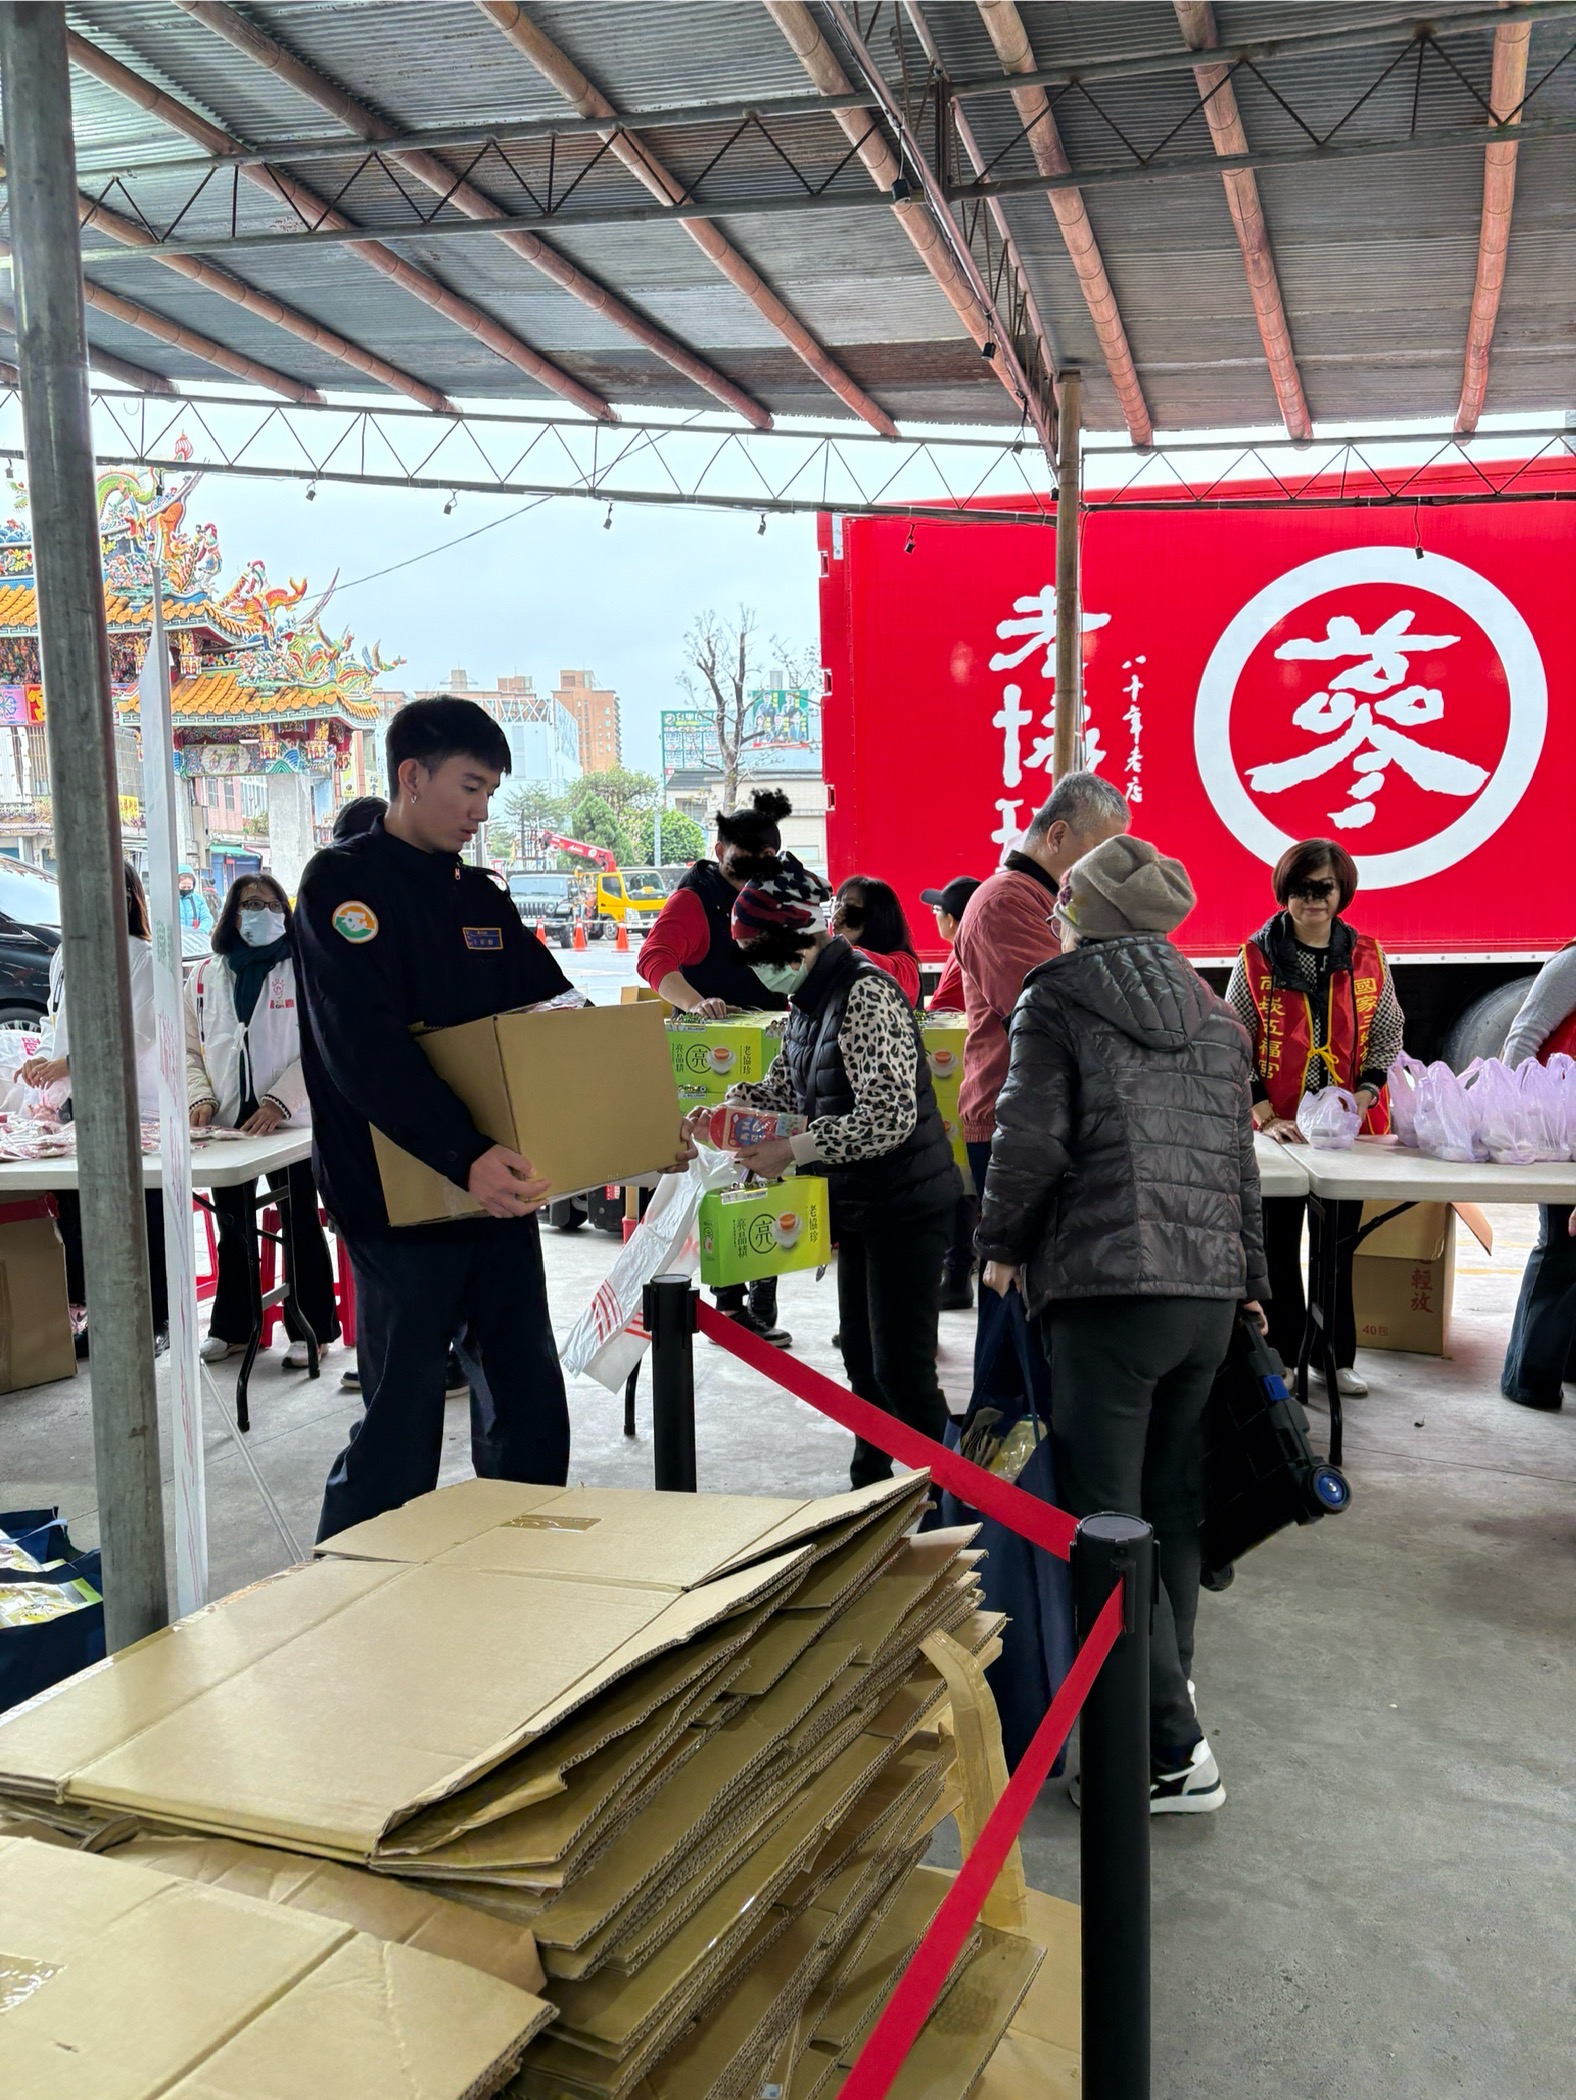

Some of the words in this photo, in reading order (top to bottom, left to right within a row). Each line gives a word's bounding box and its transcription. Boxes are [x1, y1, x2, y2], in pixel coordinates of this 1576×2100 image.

[1121, 654, 1147, 803] 八十年老店
